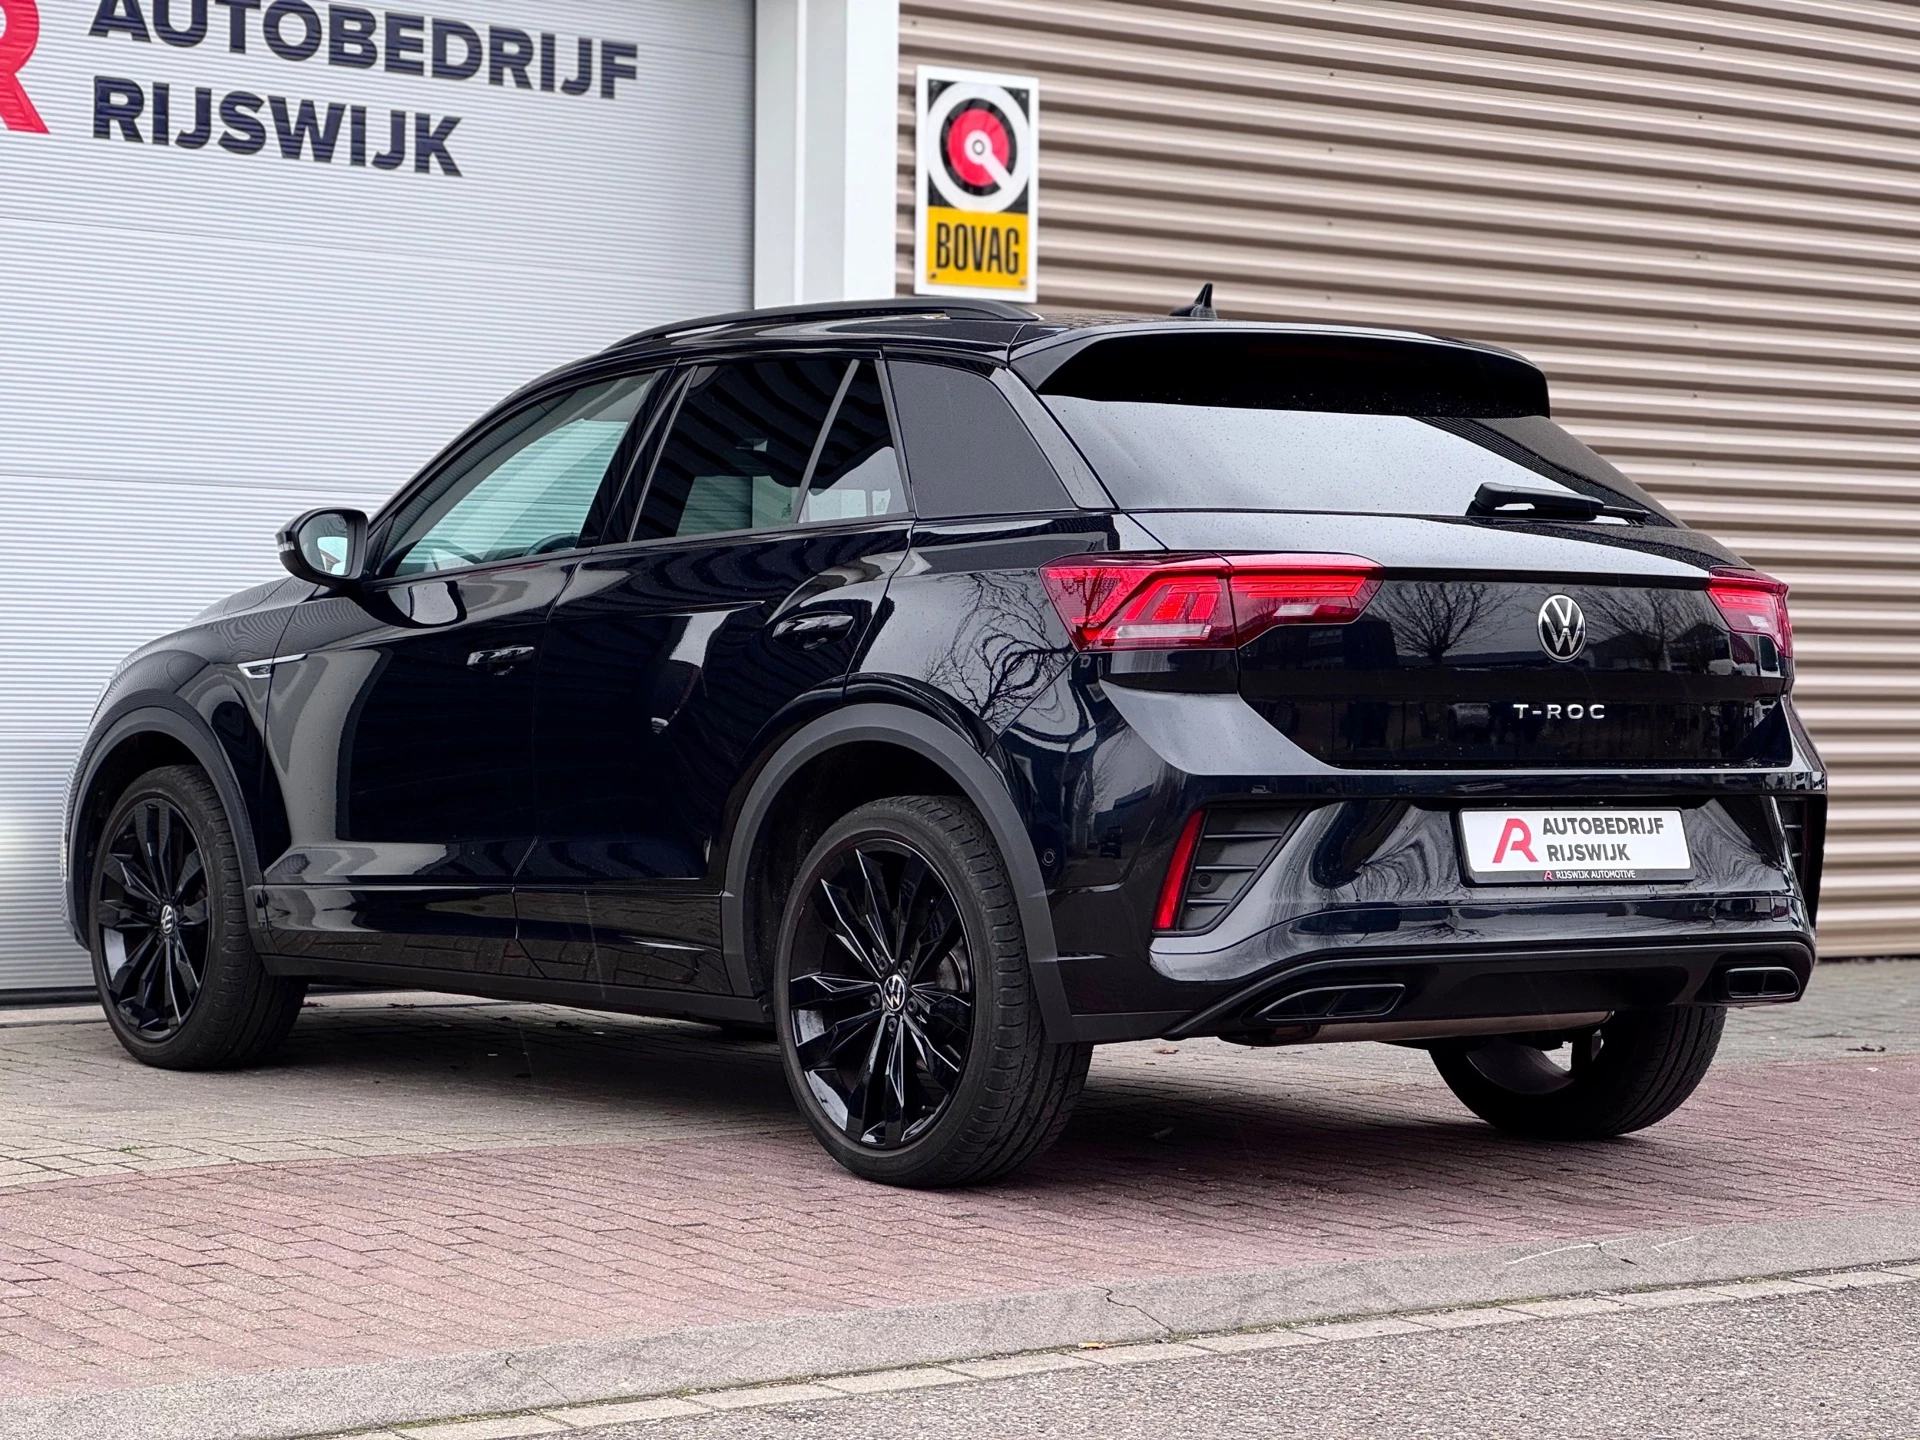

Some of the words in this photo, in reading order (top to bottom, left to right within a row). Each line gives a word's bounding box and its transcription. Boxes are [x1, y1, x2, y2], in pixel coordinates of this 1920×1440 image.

[88, 0, 639, 100] AUTOBEDRIJF
[93, 75, 463, 178] RIJSWIJK
[935, 221, 1020, 276] BOVAG
[1512, 703, 1606, 720] T-ROC
[1543, 817, 1664, 835] AUTOBEDRIJF
[1546, 844, 1631, 862] RIJSWIJK
[1555, 870, 1590, 879] RIJSWIJK
[1590, 869, 1636, 879] AUTOMOTIVE
